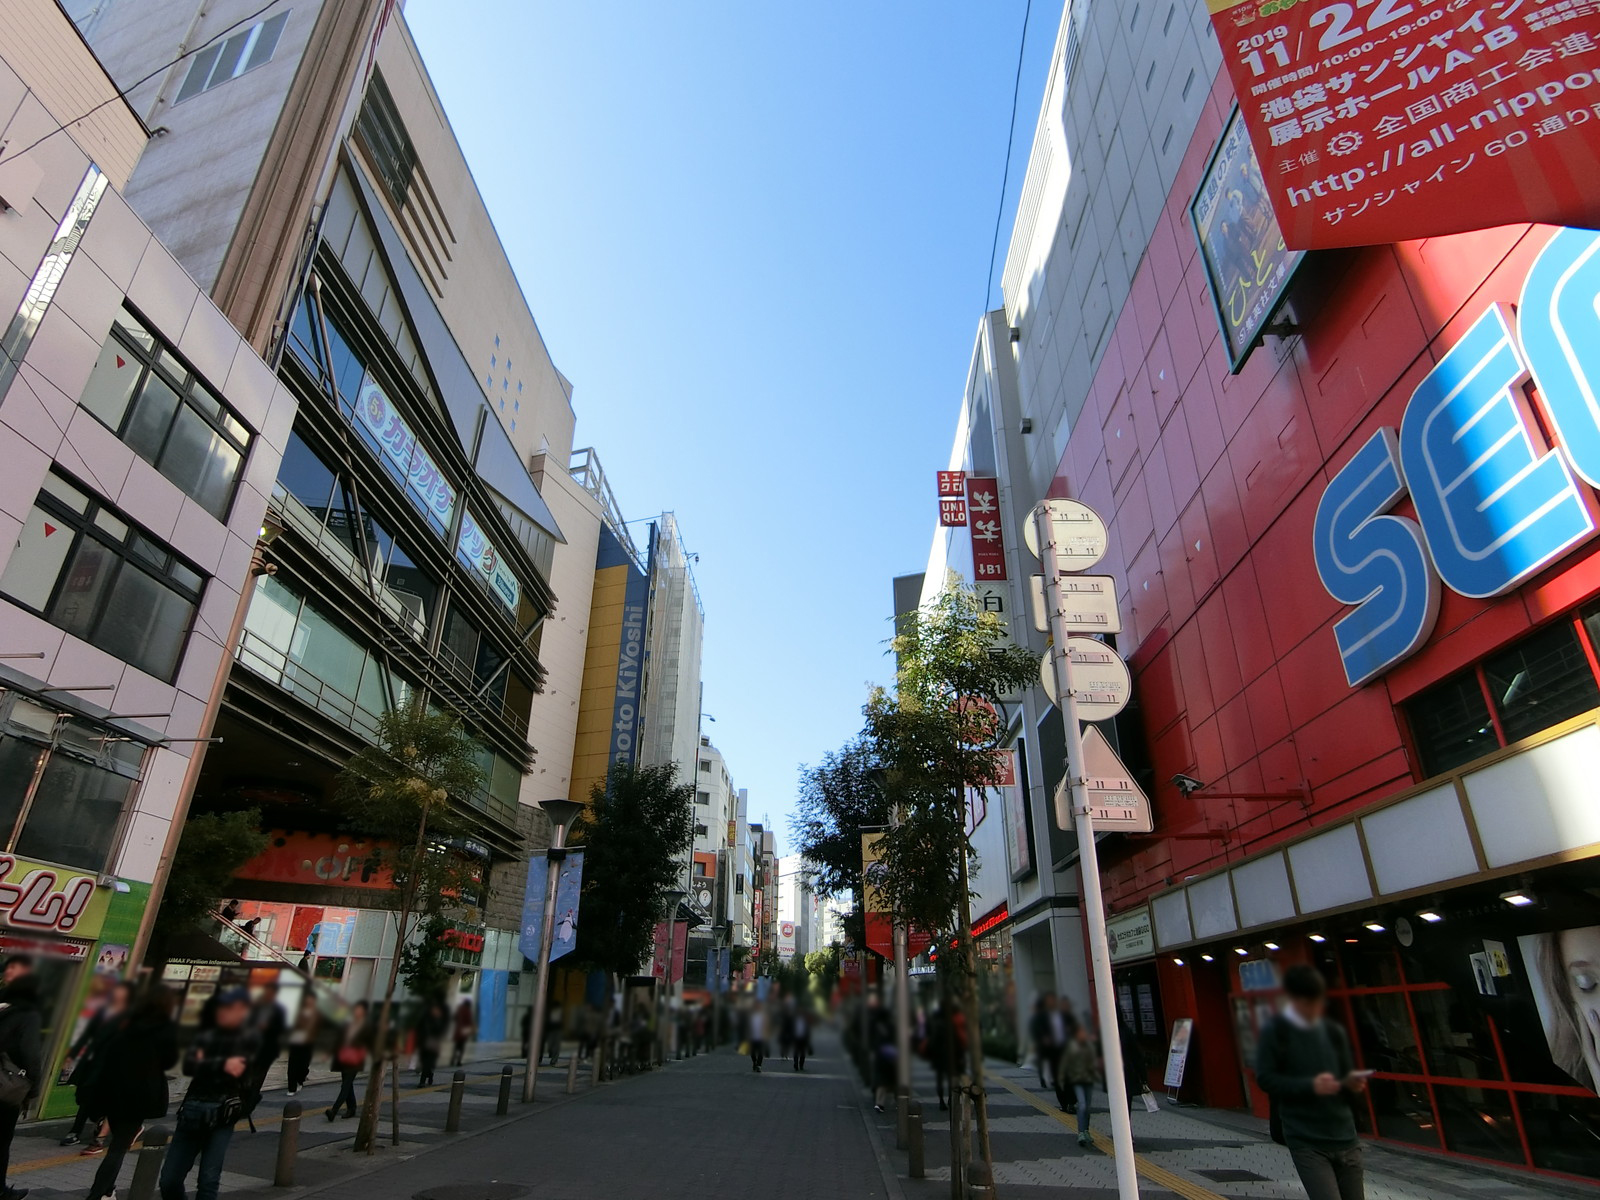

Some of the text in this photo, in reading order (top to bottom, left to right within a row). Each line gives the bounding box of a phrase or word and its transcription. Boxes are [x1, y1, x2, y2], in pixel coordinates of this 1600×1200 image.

[1237, 26, 1289, 53] 2019
[1260, 0, 1546, 122] 池袋サンシャイン
[1279, 150, 1320, 174] 主催
[1322, 152, 1475, 226] サンシャイン
[1484, 130, 1528, 157] 60
[986, 564, 1001, 575] B1
